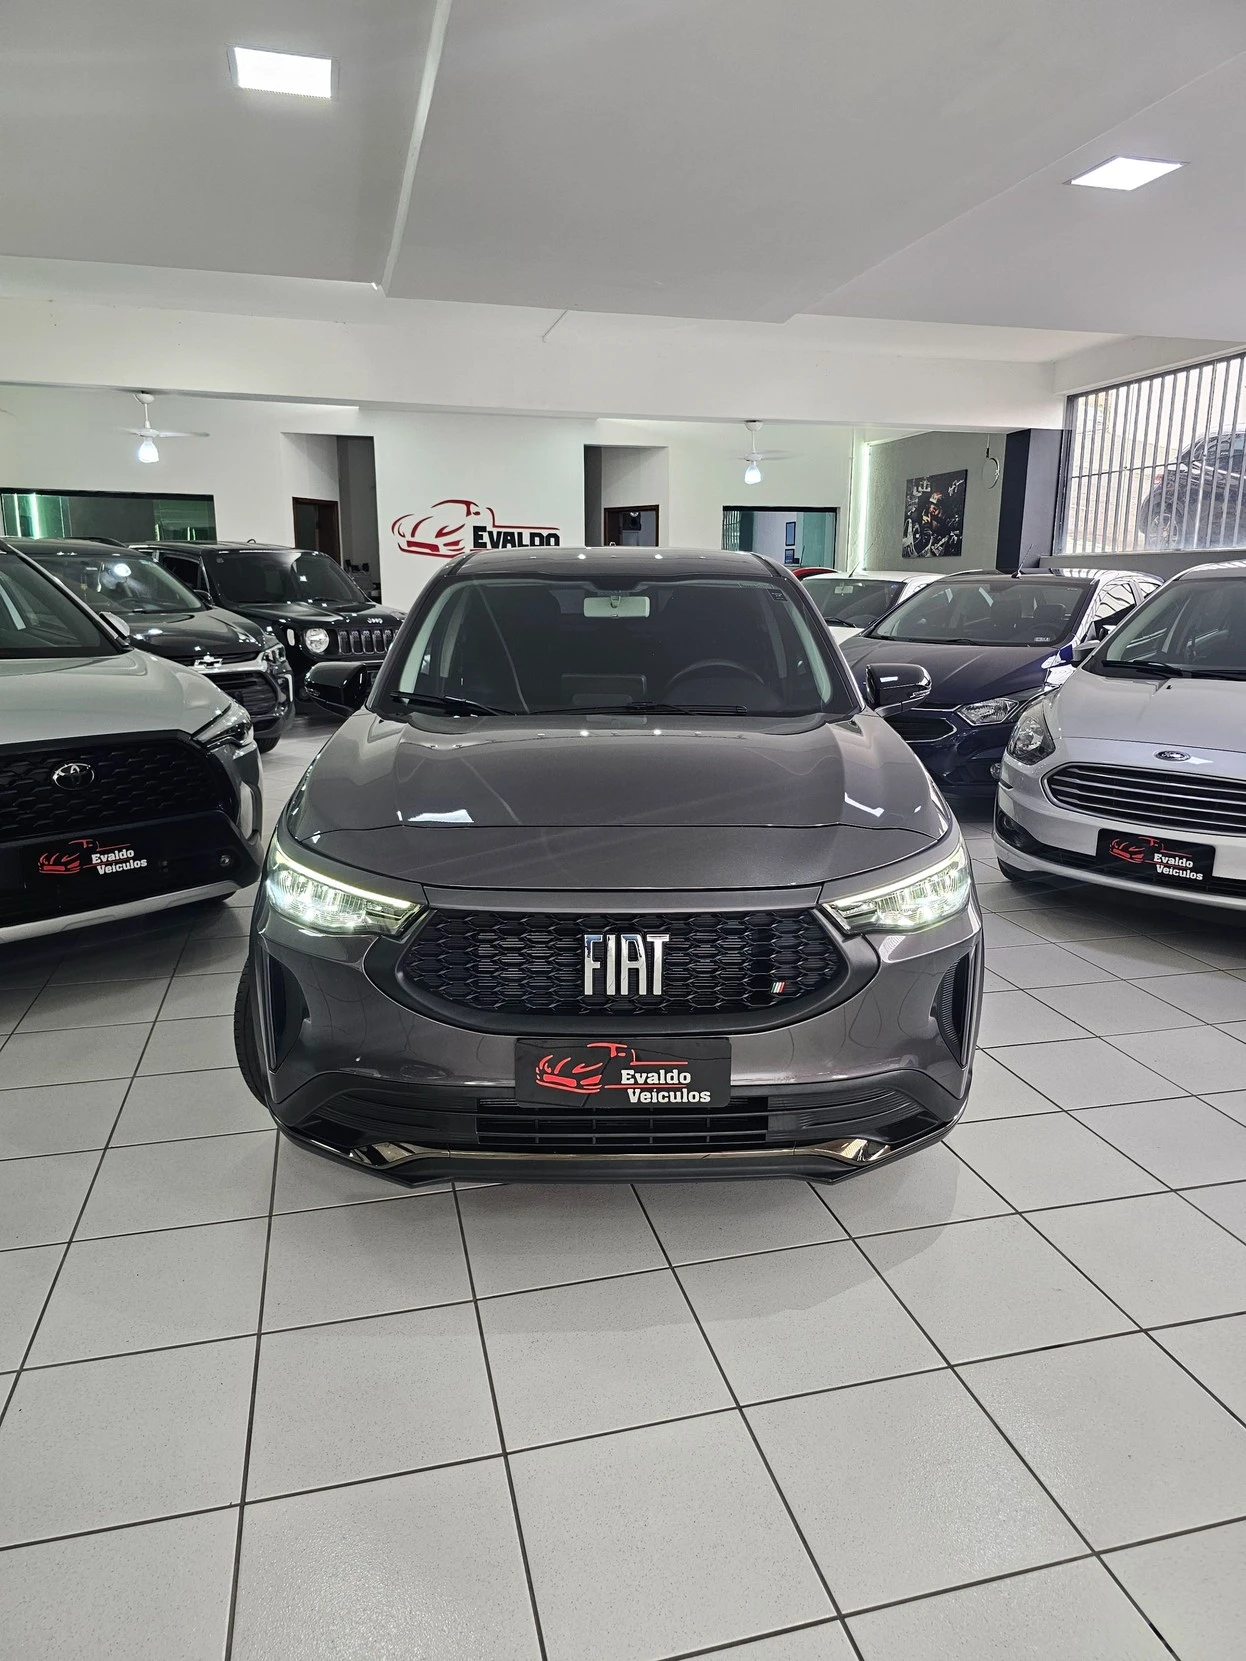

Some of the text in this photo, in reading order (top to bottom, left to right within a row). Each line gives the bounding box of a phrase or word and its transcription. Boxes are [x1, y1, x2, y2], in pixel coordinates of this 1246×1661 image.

[472, 525, 560, 549] EVALDO
[91, 849, 135, 864] Evaldo
[1153, 853, 1194, 868] Evaldo
[584, 934, 669, 996] FIAT
[621, 1069, 692, 1084] Evaldo
